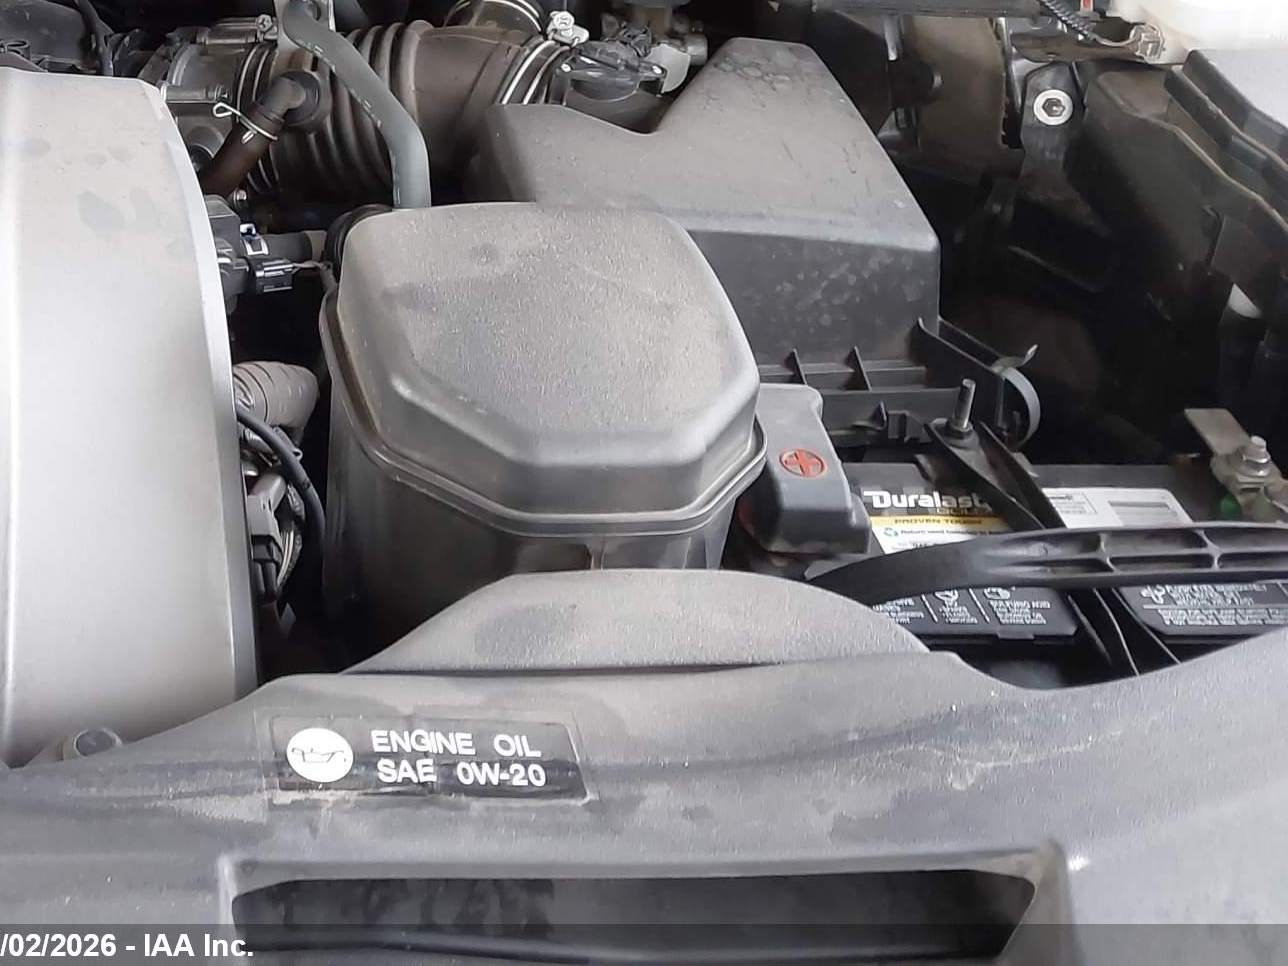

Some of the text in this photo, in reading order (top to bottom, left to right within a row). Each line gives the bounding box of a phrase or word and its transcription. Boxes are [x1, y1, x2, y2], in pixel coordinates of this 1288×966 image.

[863, 490, 988, 509] Duralast
[370, 729, 542, 758] ENGINE OIL
[376, 758, 547, 788] SAE 0W-20
